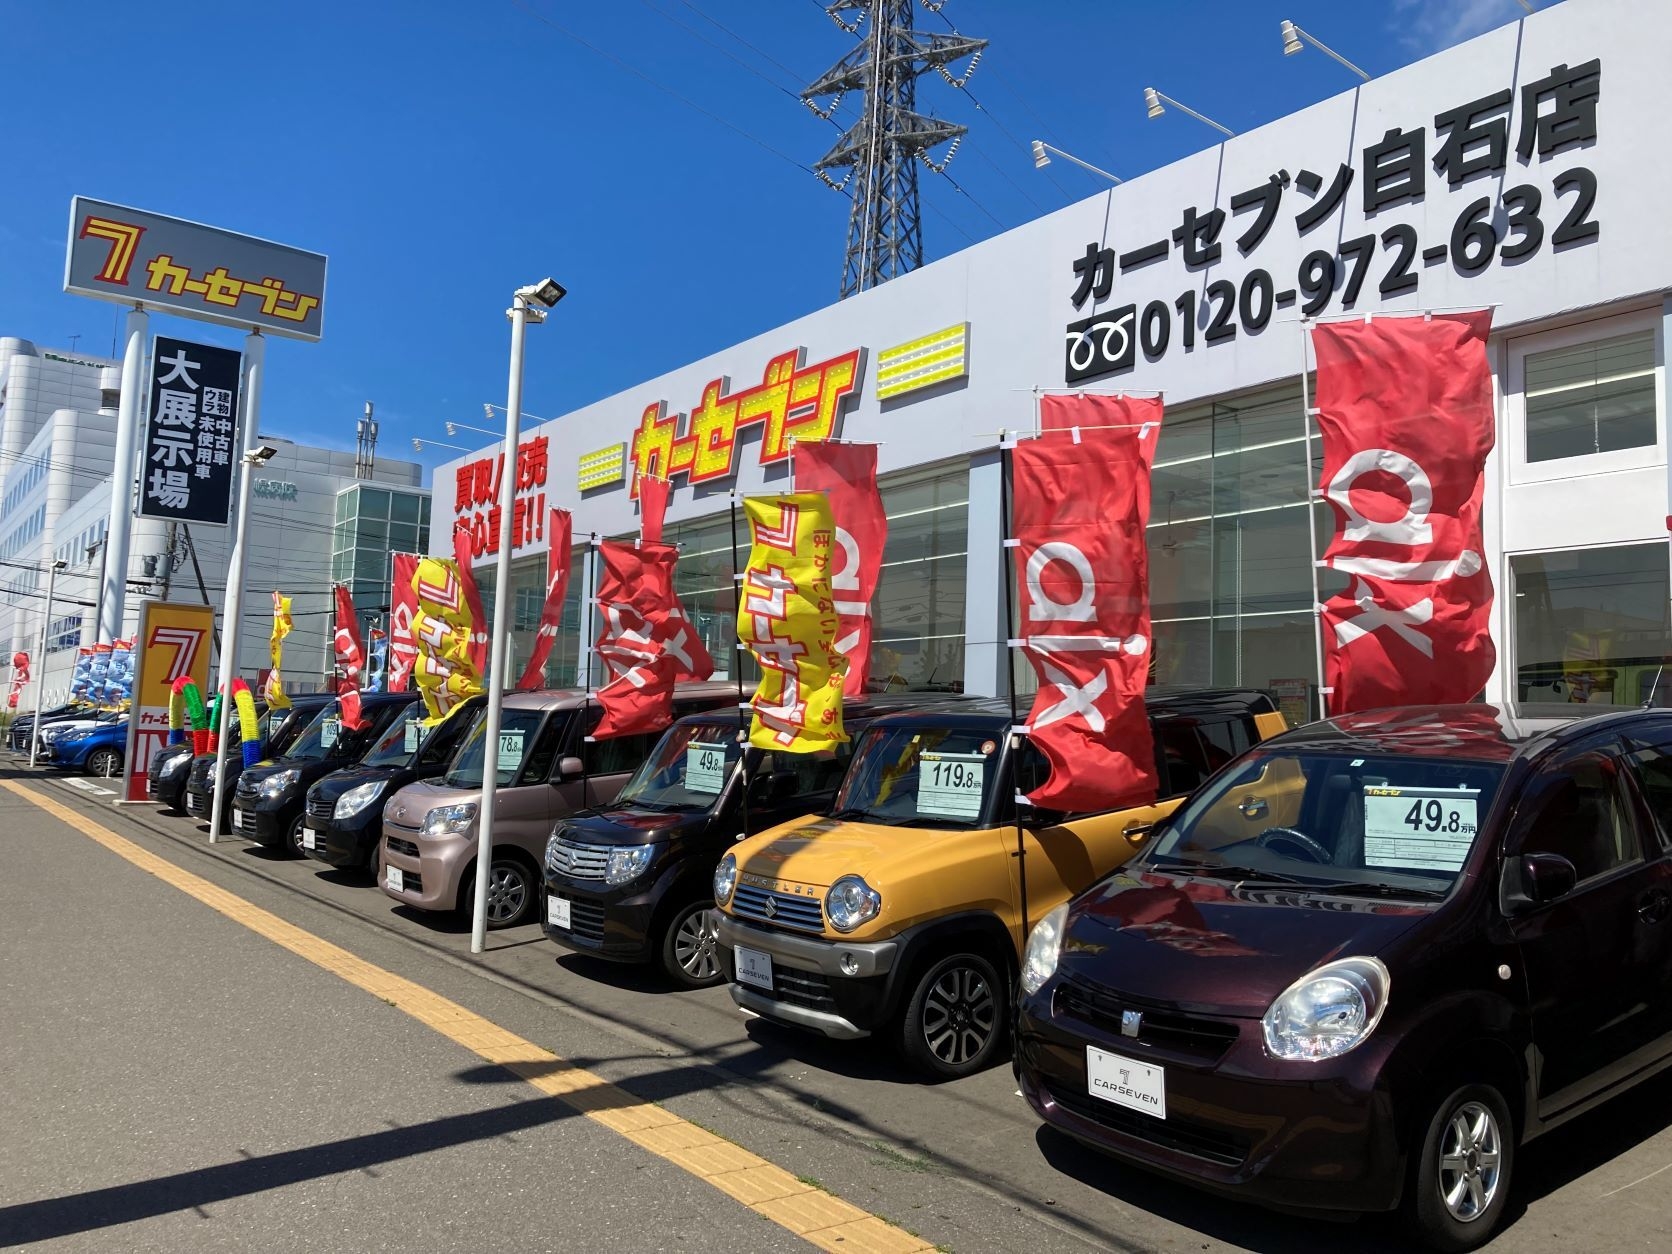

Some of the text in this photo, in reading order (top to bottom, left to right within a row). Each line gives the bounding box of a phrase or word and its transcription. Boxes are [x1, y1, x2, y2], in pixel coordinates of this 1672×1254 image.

[1071, 58, 1600, 306] カーセブン白石店
[146, 255, 320, 323] カーセブン
[1139, 167, 1600, 357] 0120-972-632
[148, 349, 201, 509] 大展示場
[194, 415, 216, 480] 未使用車
[212, 418, 232, 466] 中古車
[630, 346, 864, 502] カーセブン
[1094, 1078, 1158, 1105] CARSEVEN
